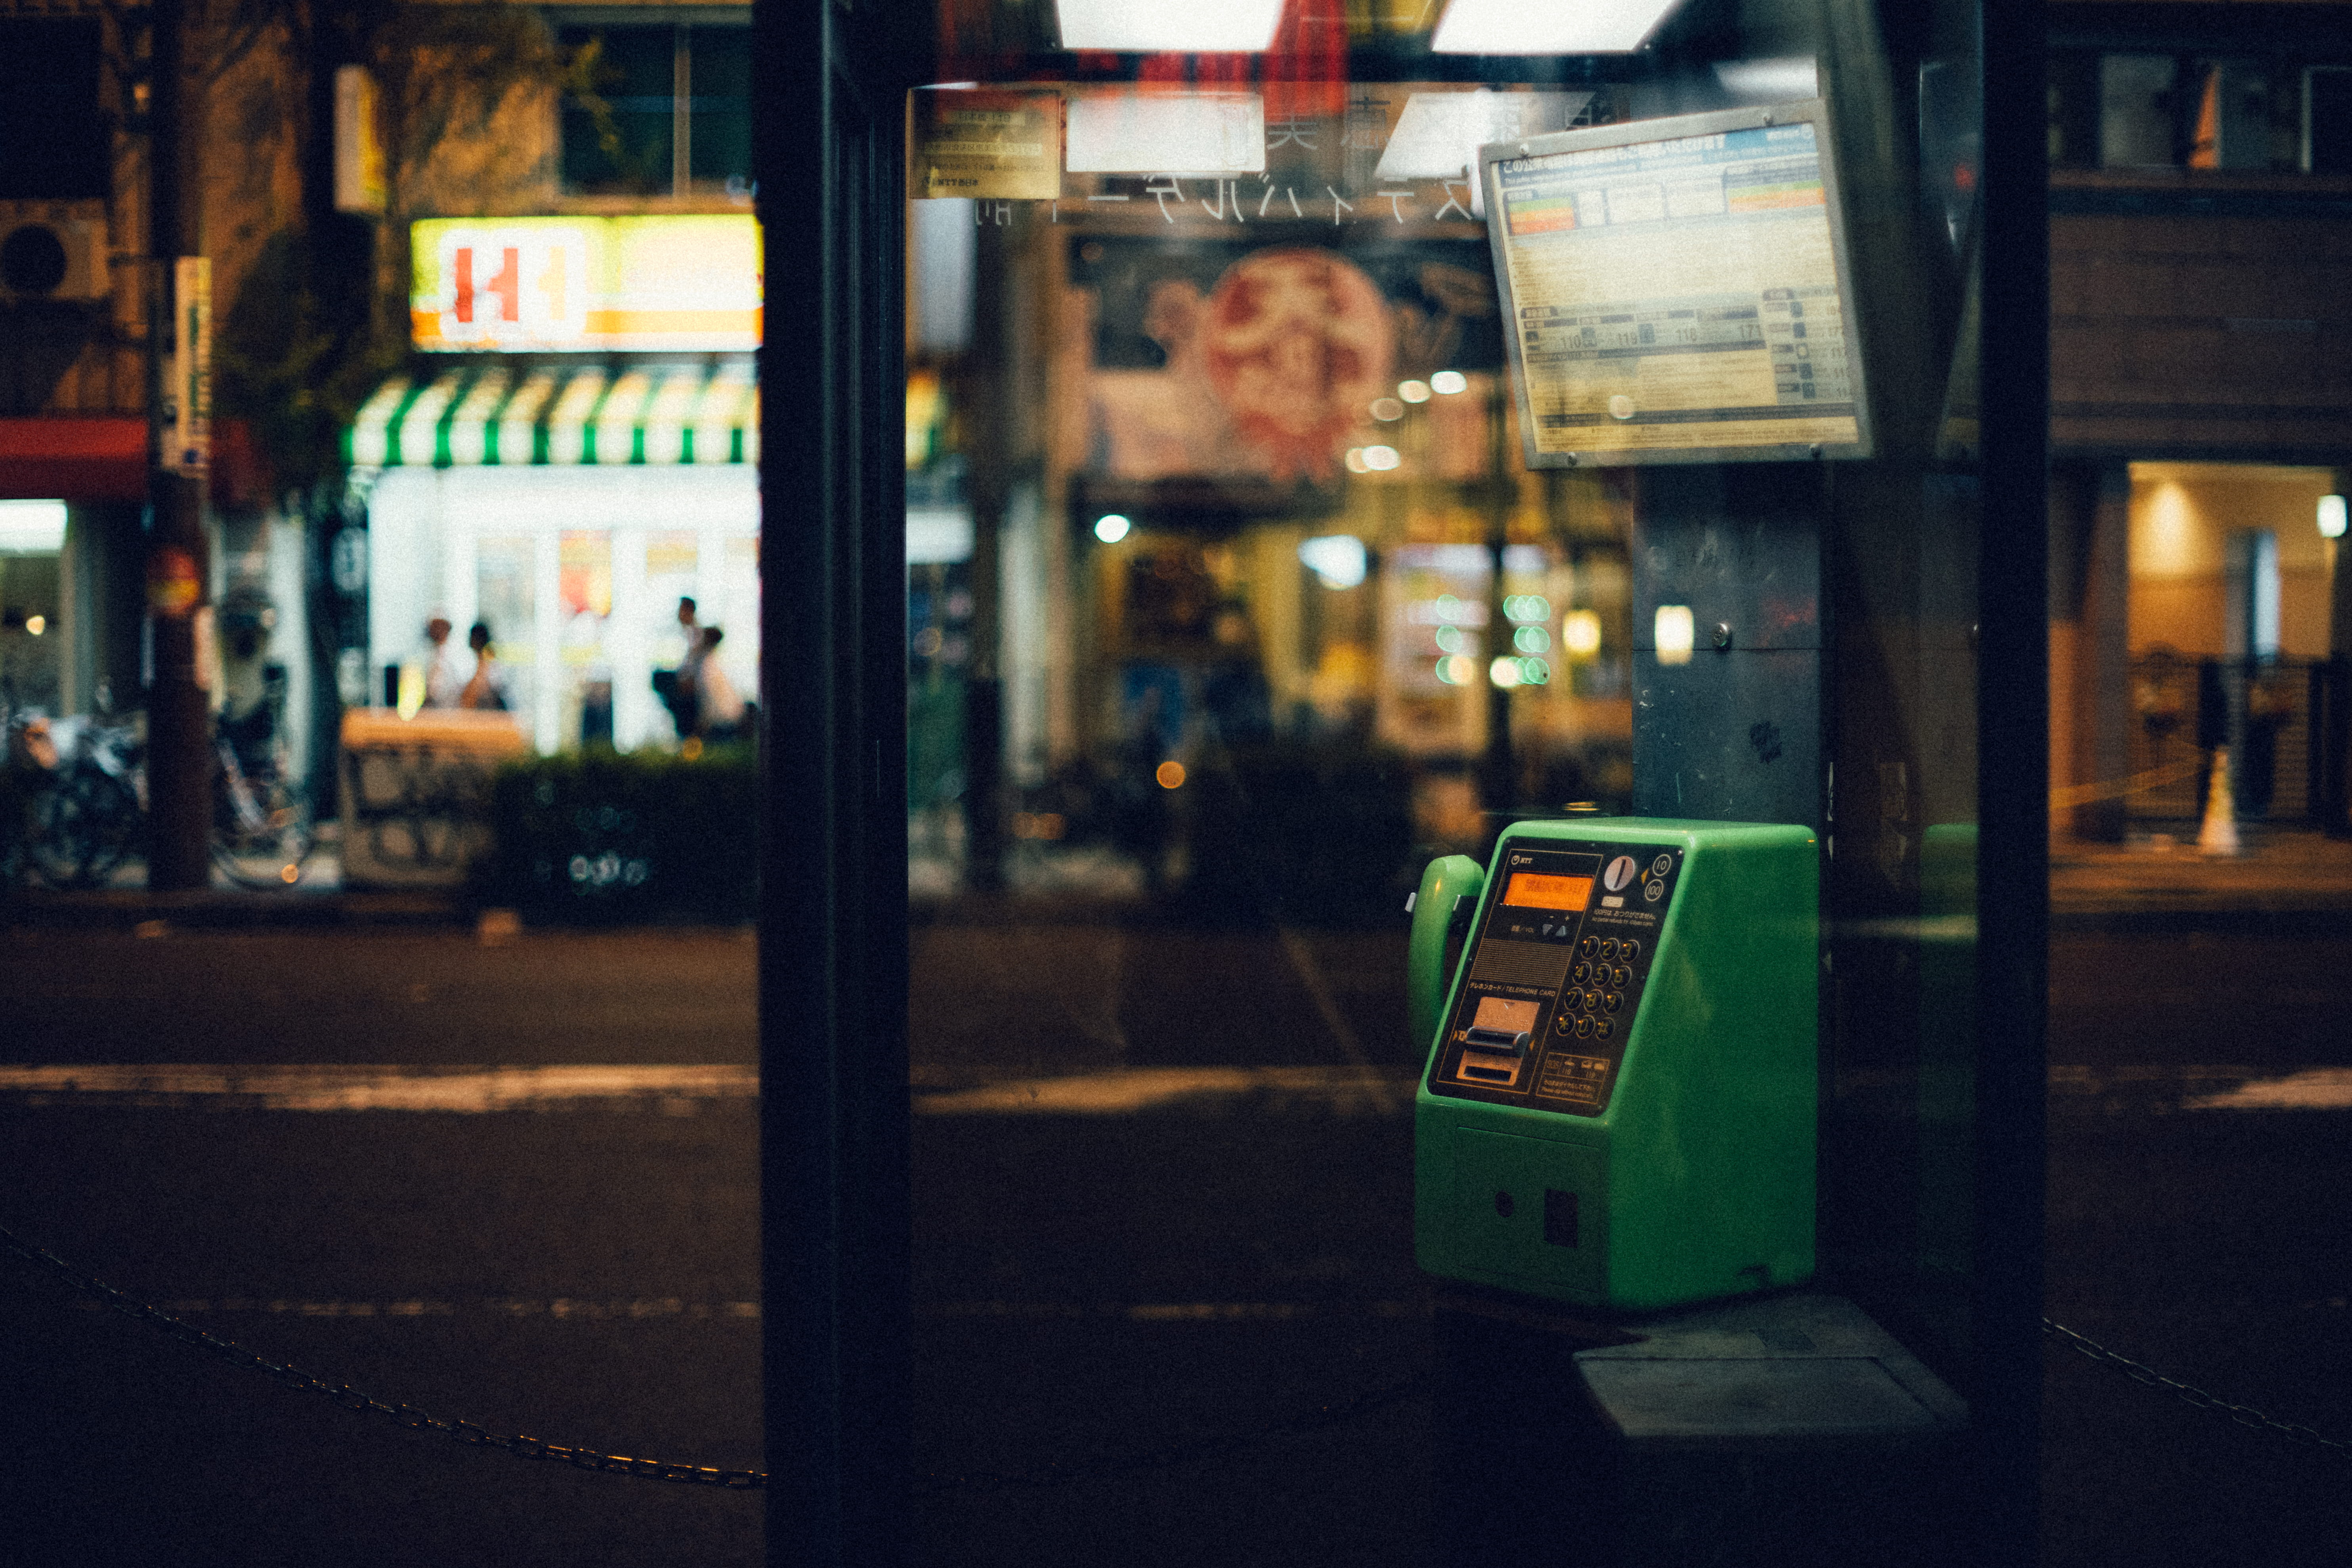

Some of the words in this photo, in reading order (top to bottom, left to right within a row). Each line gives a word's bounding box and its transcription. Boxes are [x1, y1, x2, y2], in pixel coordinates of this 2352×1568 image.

[1657, 860, 1667, 870] 10
[1647, 886, 1660, 895] 100
[1586, 940, 1591, 953] 1
[1603, 941, 1612, 955] 2
[1622, 943, 1632, 957] 3
[1575, 965, 1584, 979] 4
[1595, 966, 1605, 981] 5
[1614, 969, 1624, 983] 6
[1470, 982, 1501, 991] テレホンカード
[1506, 986, 1538, 995] TELEPHONE
[1567, 991, 1578, 1005] 7
[1587, 993, 1597, 1007] 8
[1608, 995, 1616, 1009] 9
